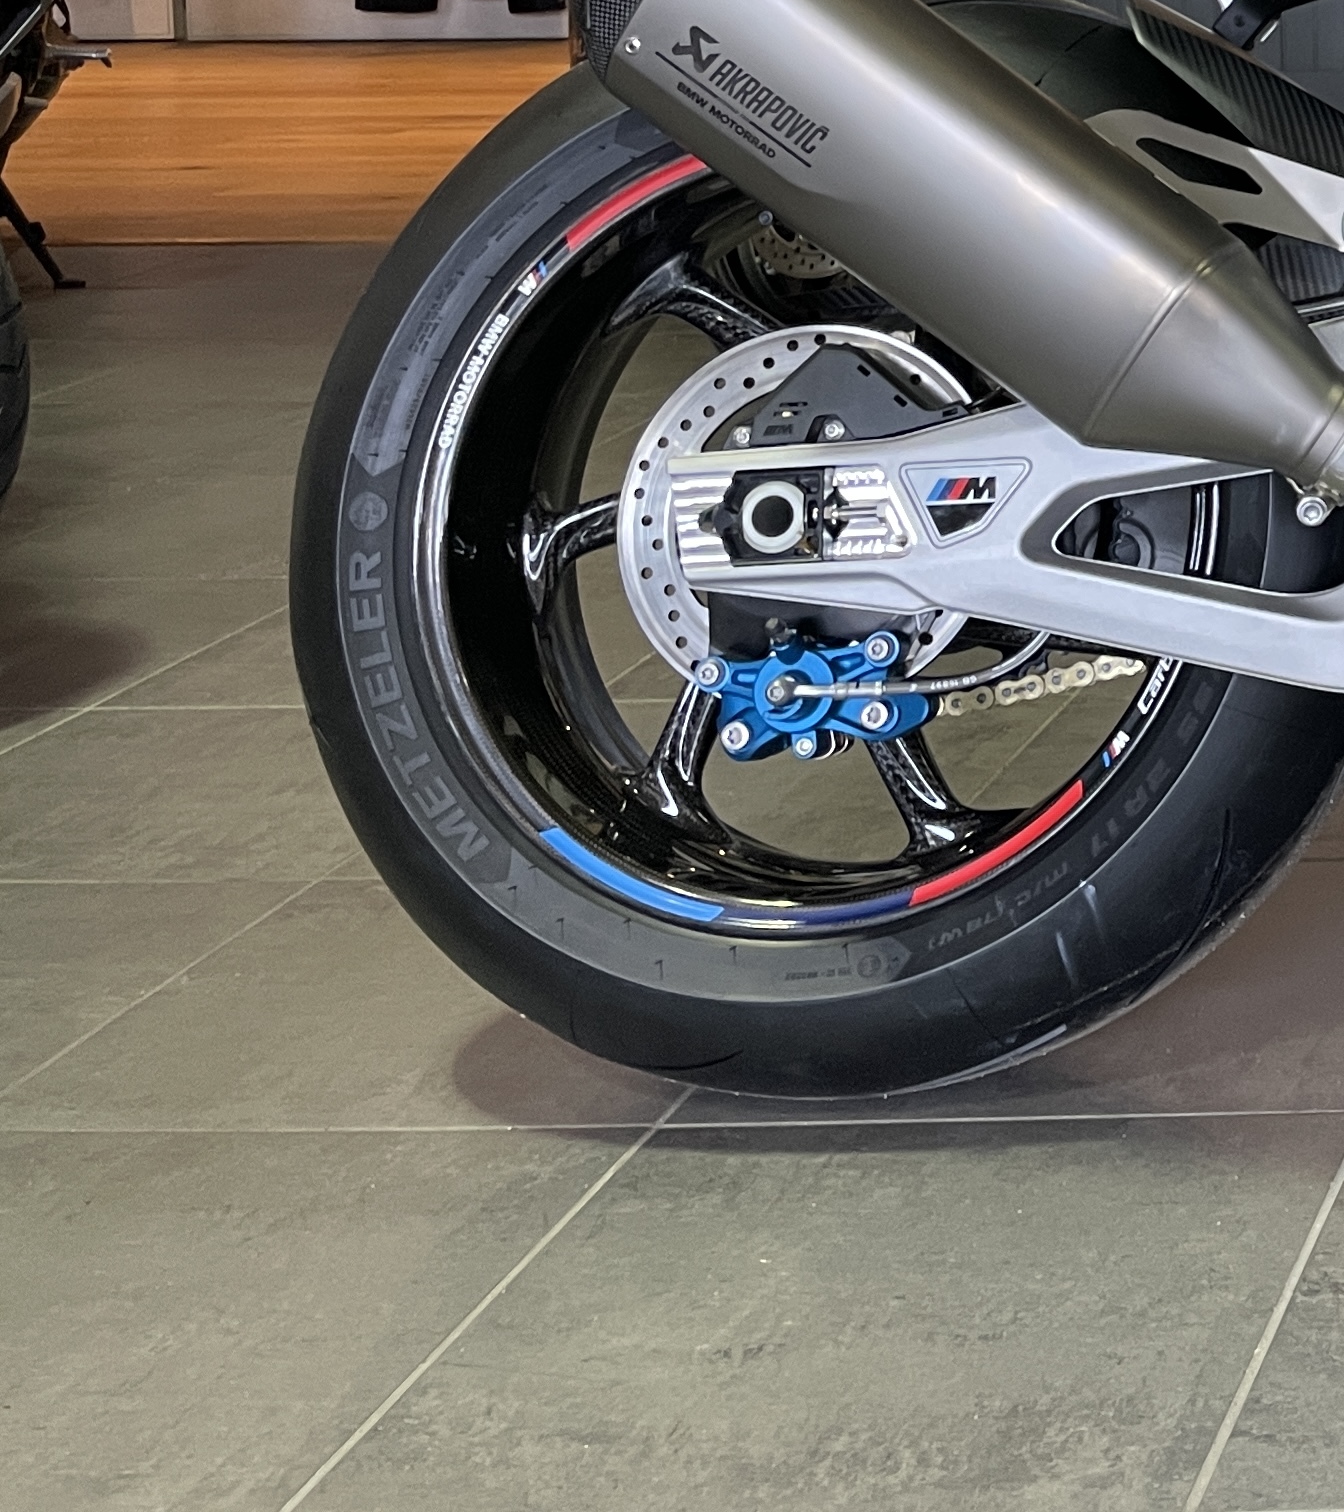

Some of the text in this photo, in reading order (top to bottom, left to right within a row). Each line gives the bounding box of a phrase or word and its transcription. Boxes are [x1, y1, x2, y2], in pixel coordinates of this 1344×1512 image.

[676, 81, 776, 159] BMW MOTORRAD
[709, 58, 830, 155] AKRAPOVIČ
[348, 550, 491, 863] METZELER
